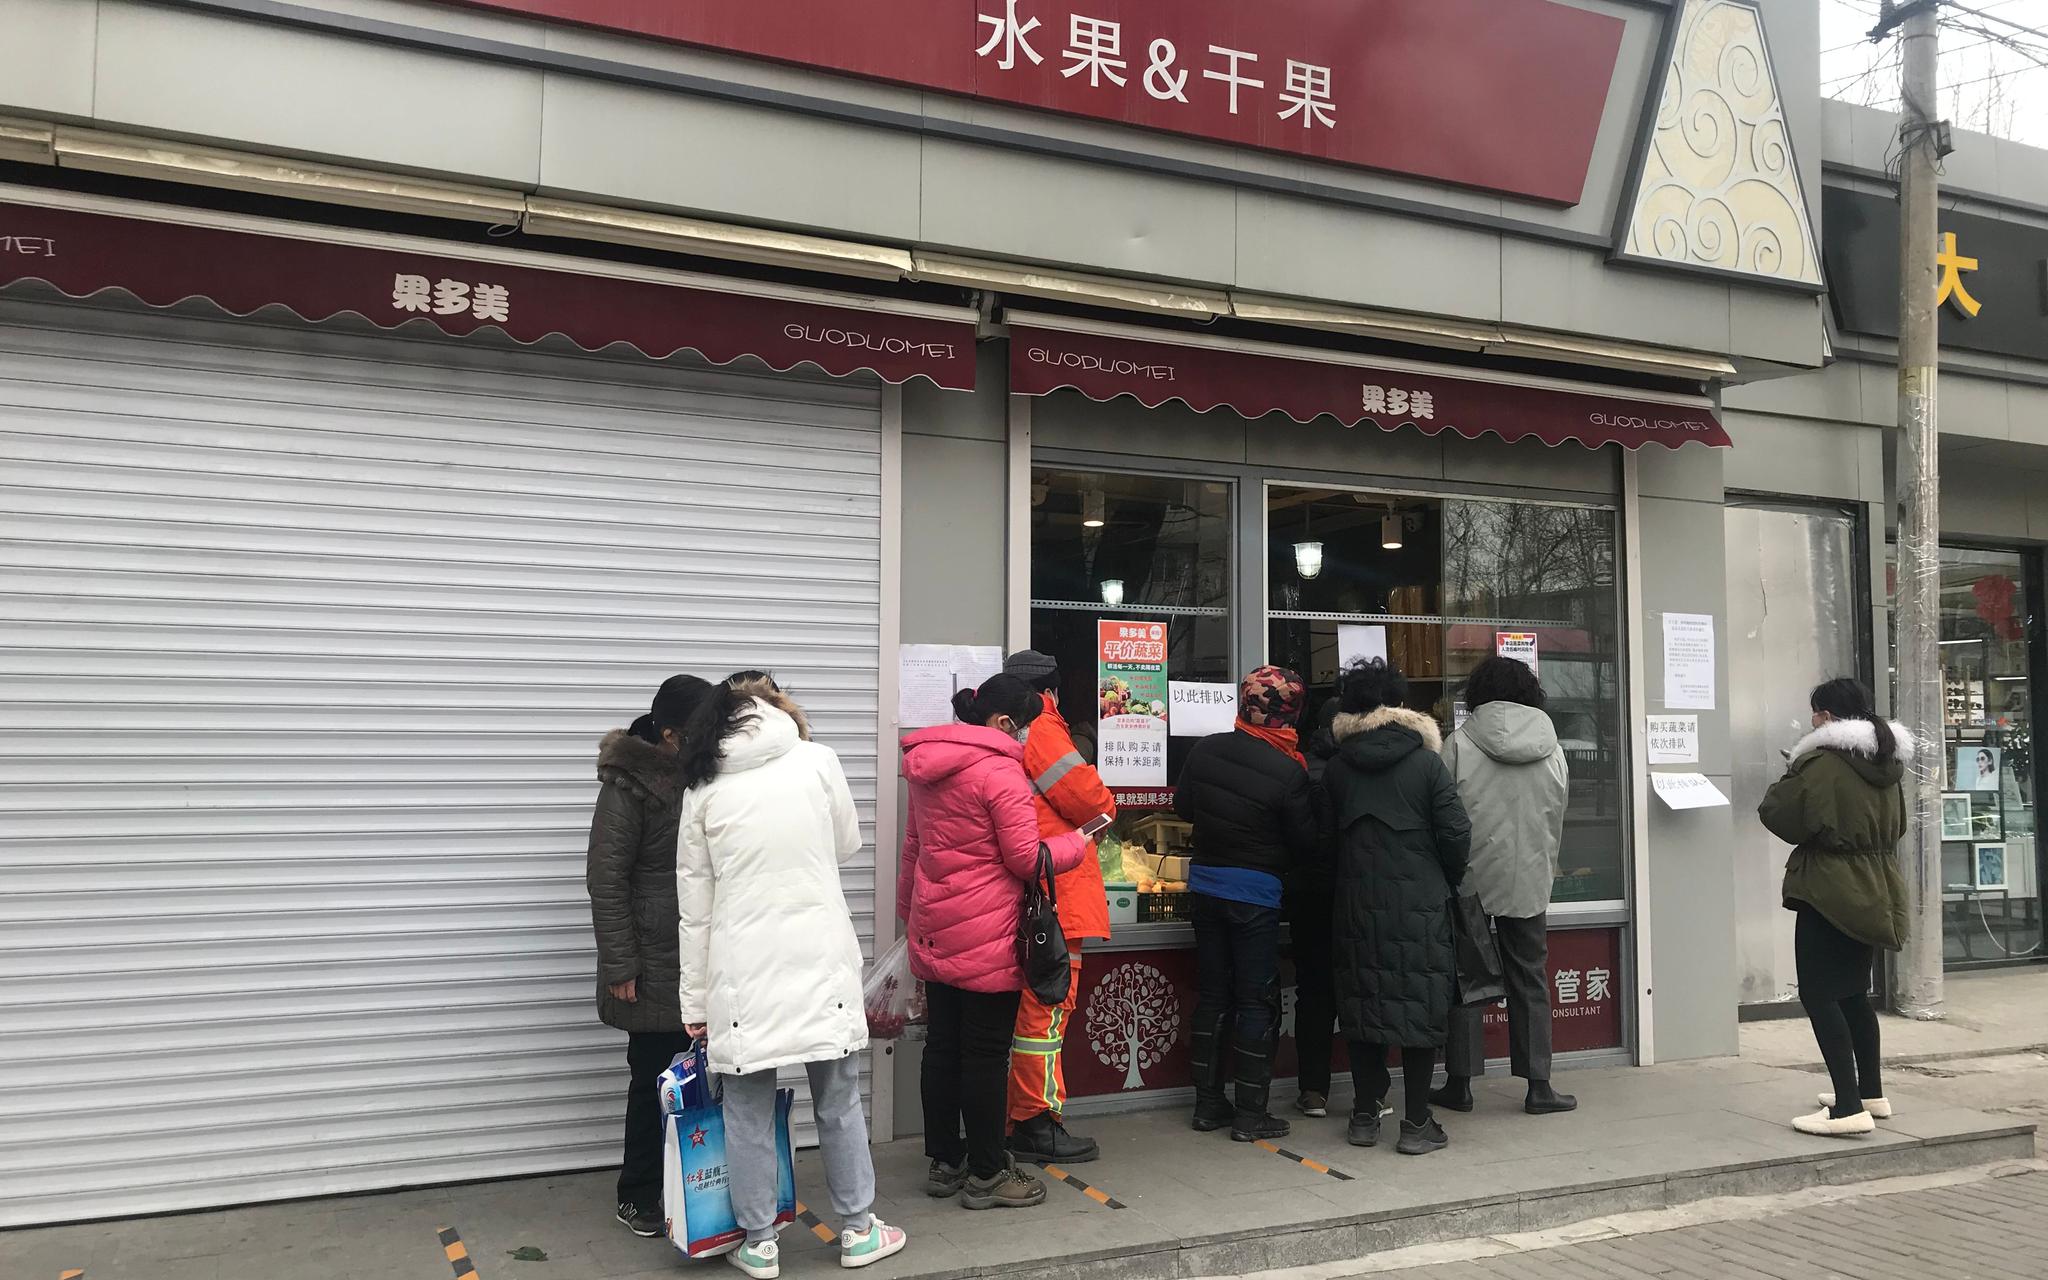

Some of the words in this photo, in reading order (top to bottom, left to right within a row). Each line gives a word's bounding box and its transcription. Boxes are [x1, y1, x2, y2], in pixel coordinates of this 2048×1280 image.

[974, 0, 1336, 129] 水果&干果
[392, 273, 509, 322] 果多美
[784, 323, 955, 359] GUODUOMEI
[1028, 347, 1175, 382] GUODUOMEI
[1362, 383, 1434, 420] 果多美
[1589, 412, 1709, 431] GUODUOMEI
[1120, 627, 1146, 639] 果多美
[1104, 640, 1163, 660] 平价蔬菜
[1649, 721, 1696, 733] 购买蔬菜请
[1105, 741, 1161, 752] 排队购买请
[1650, 738, 1686, 749] 依次排队
[1105, 756, 1161, 767] 保持1米距离
[1555, 966, 1611, 1003] 管家
